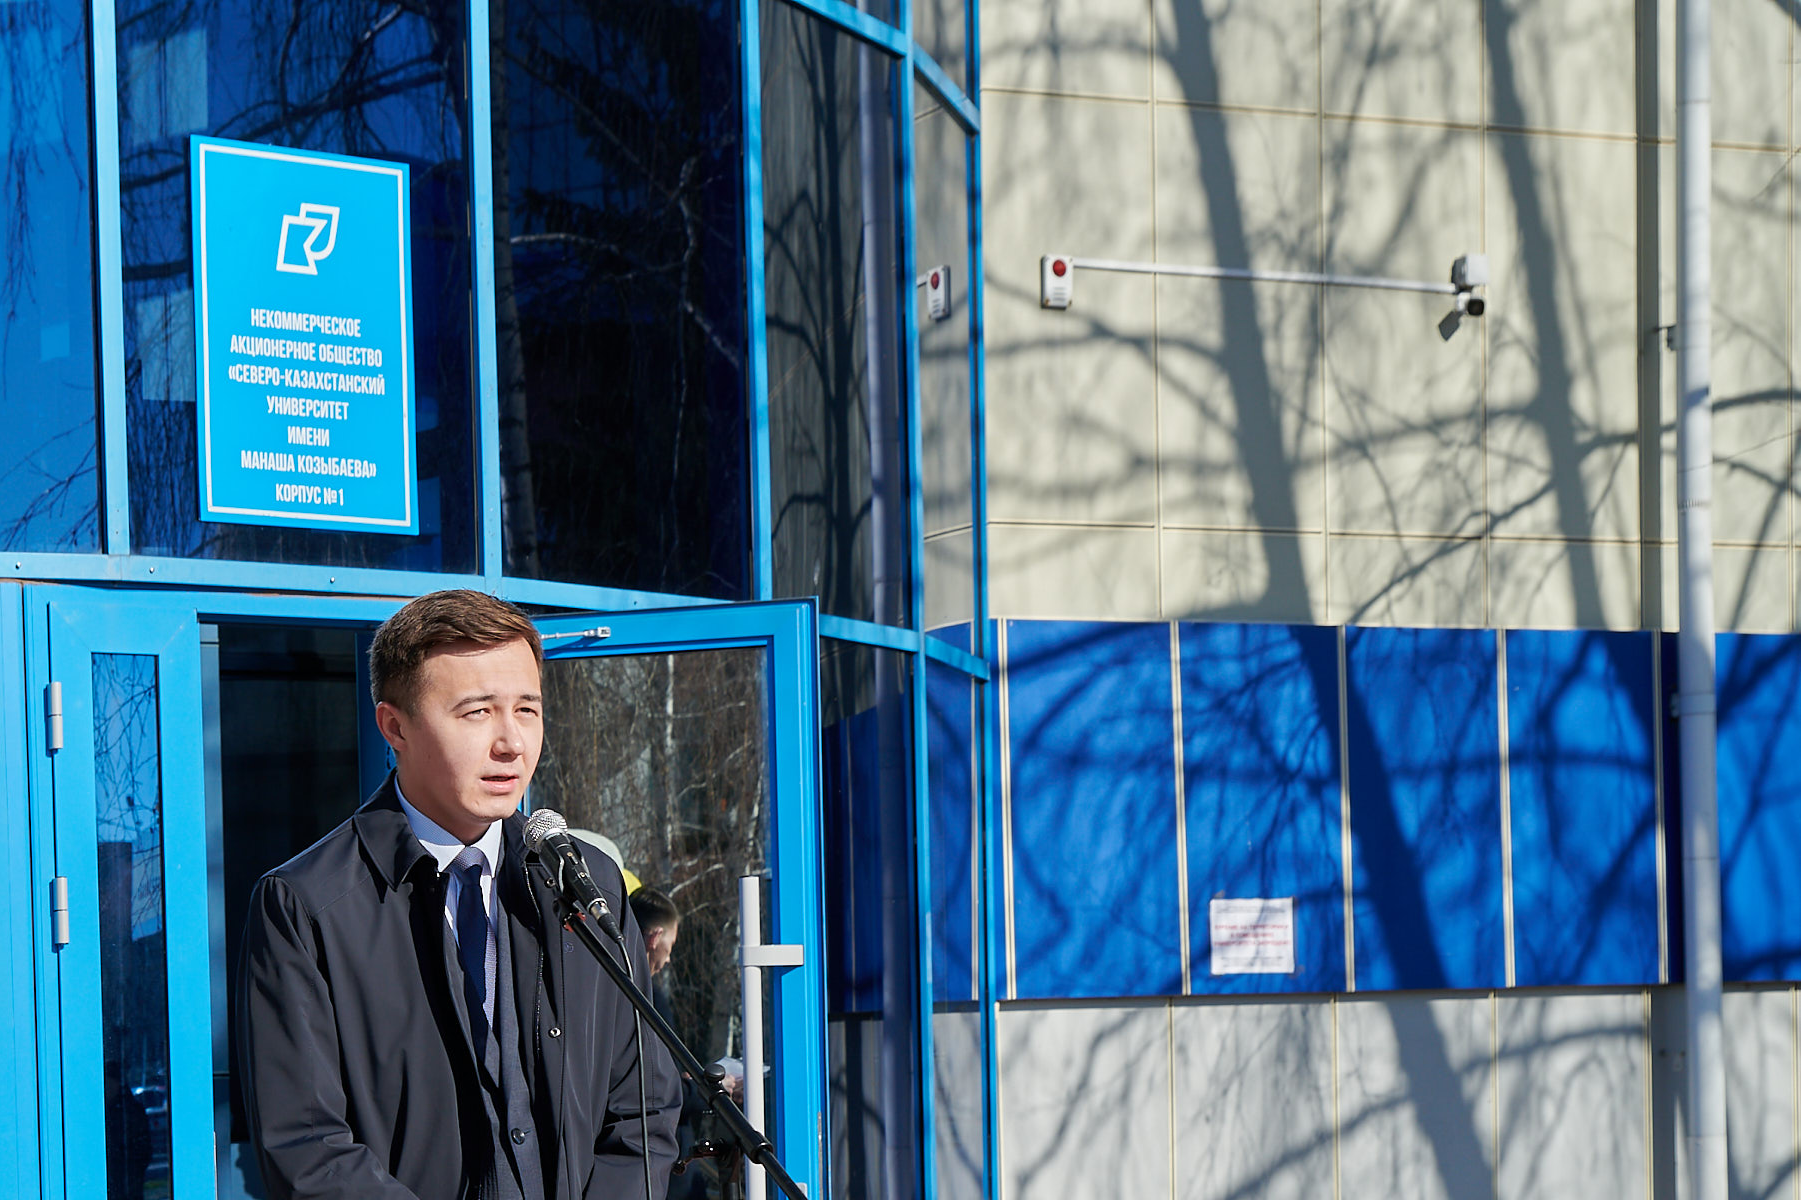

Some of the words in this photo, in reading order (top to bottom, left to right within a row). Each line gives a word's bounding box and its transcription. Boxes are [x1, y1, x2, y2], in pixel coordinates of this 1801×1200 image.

[251, 308, 361, 337] НЕКОММЕРЧЕСКОЕ
[230, 335, 316, 361] АКЦИОНЕРНОЕ
[319, 344, 382, 367] ОБЩЕСТВО
[229, 364, 385, 395] «СЕВЕРО-КАЗАХСТАНСКИЙ
[267, 396, 349, 420] УНИВЕРСИТЕТ
[288, 426, 329, 446] ИМЕНИ
[241, 450, 295, 472] МАНАША
[298, 455, 376, 478] КОЗЫБАЕВА»
[276, 484, 321, 504] КОРПУС
